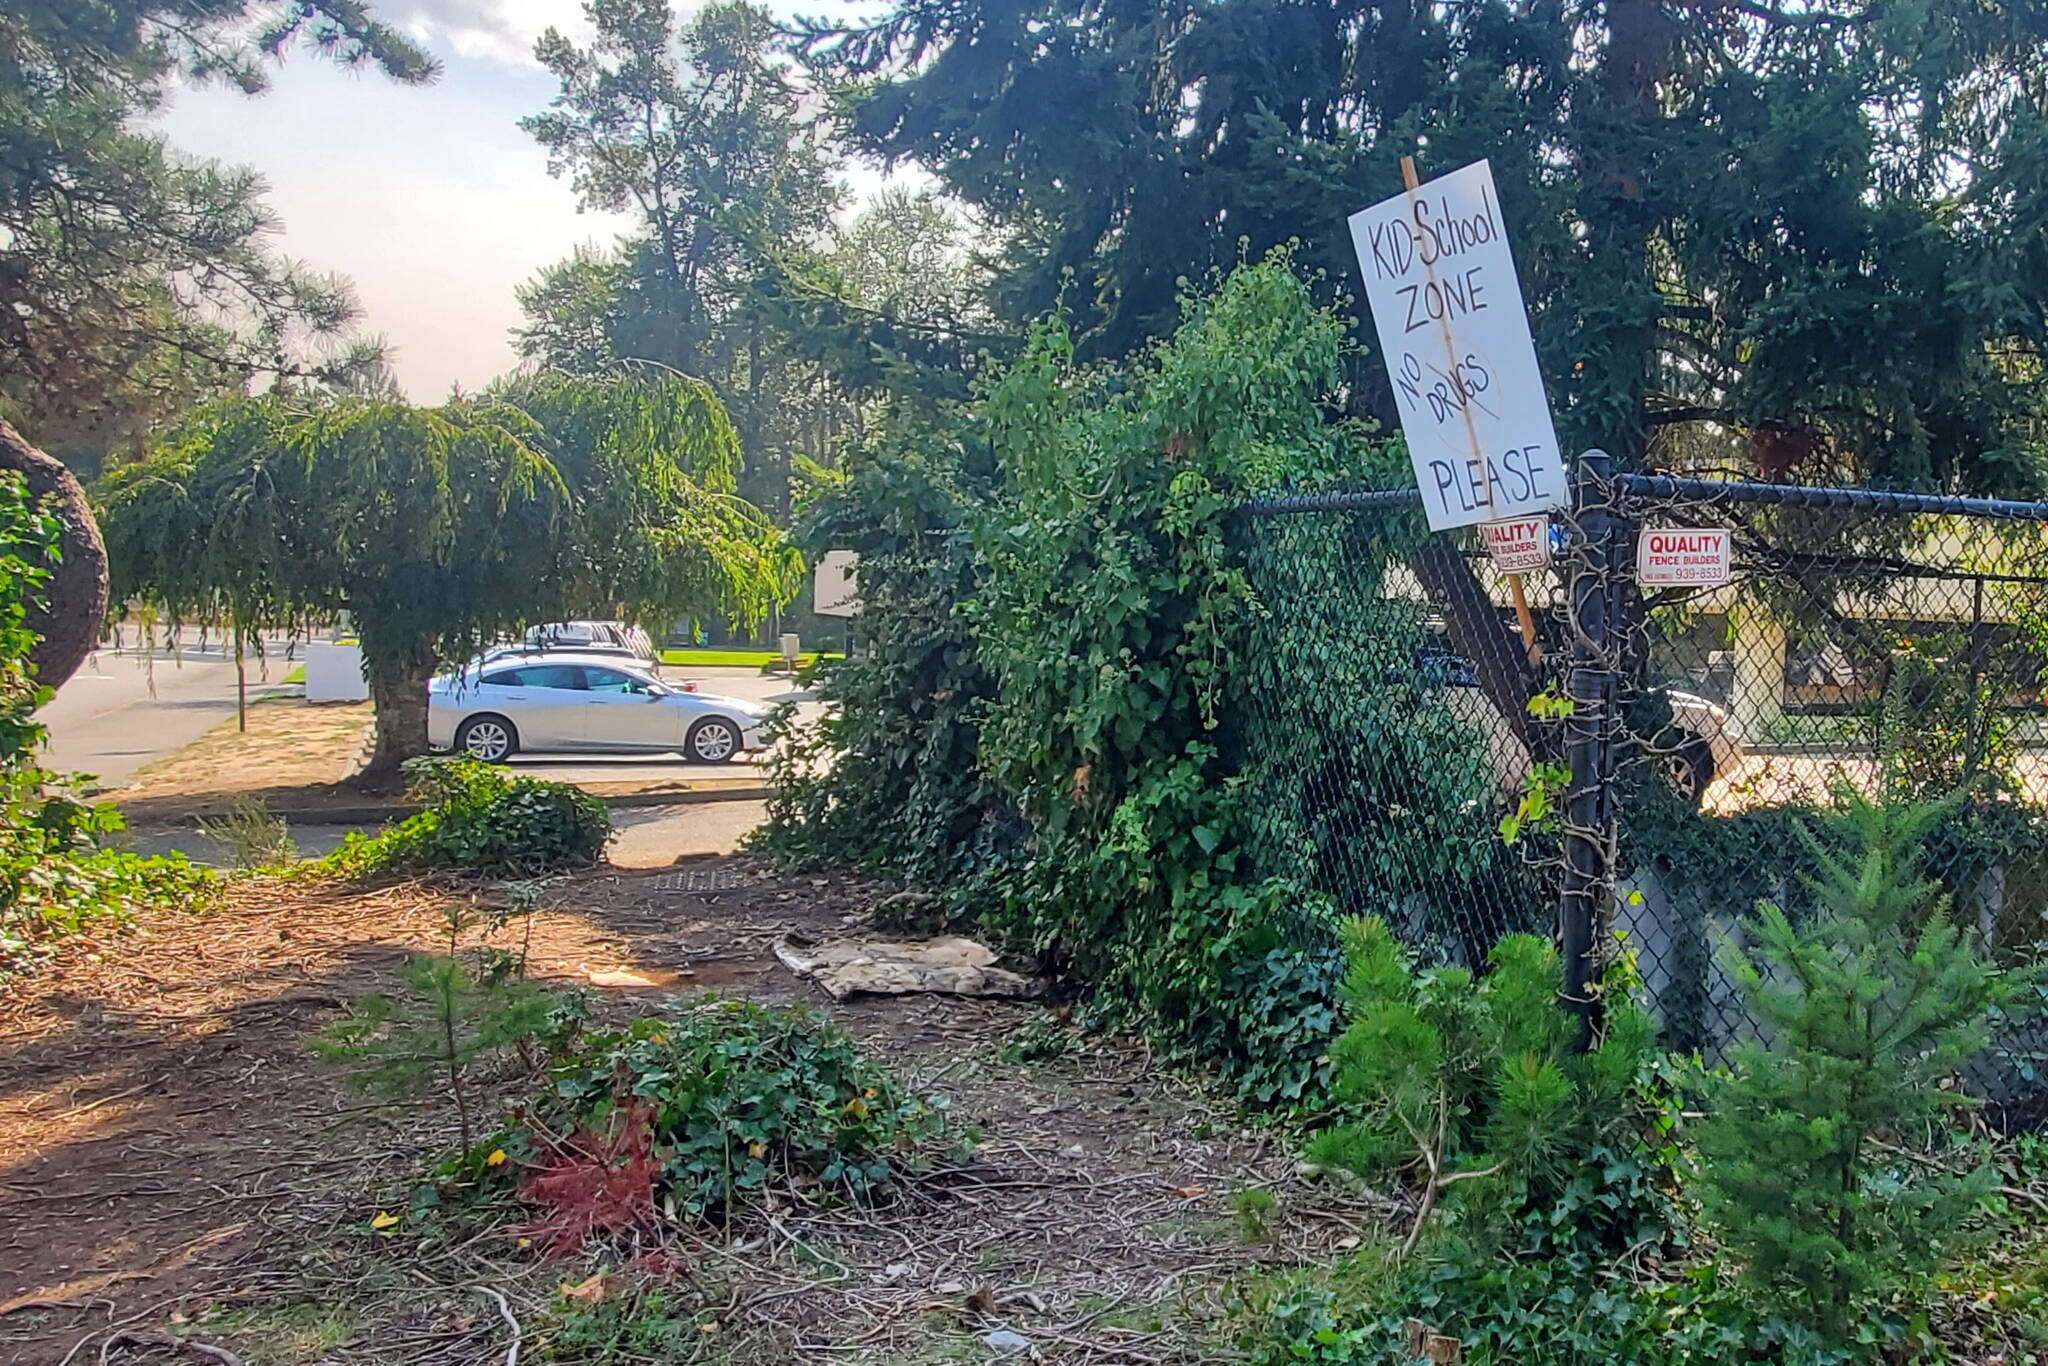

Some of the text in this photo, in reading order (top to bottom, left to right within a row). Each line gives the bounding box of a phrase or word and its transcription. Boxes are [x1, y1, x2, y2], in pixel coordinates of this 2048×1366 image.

[1395, 266, 1488, 333] ZONE
[1397, 352, 1421, 412] NO
[1426, 354, 1489, 424] DRUGS
[1429, 445, 1551, 515] PLEASE
[1484, 522, 1539, 543] UALITY
[1649, 535, 1722, 554] QUALITY
[1648, 554, 1721, 566] FENCE BUILDERS
[1675, 567, 1722, 580] 939-8533
